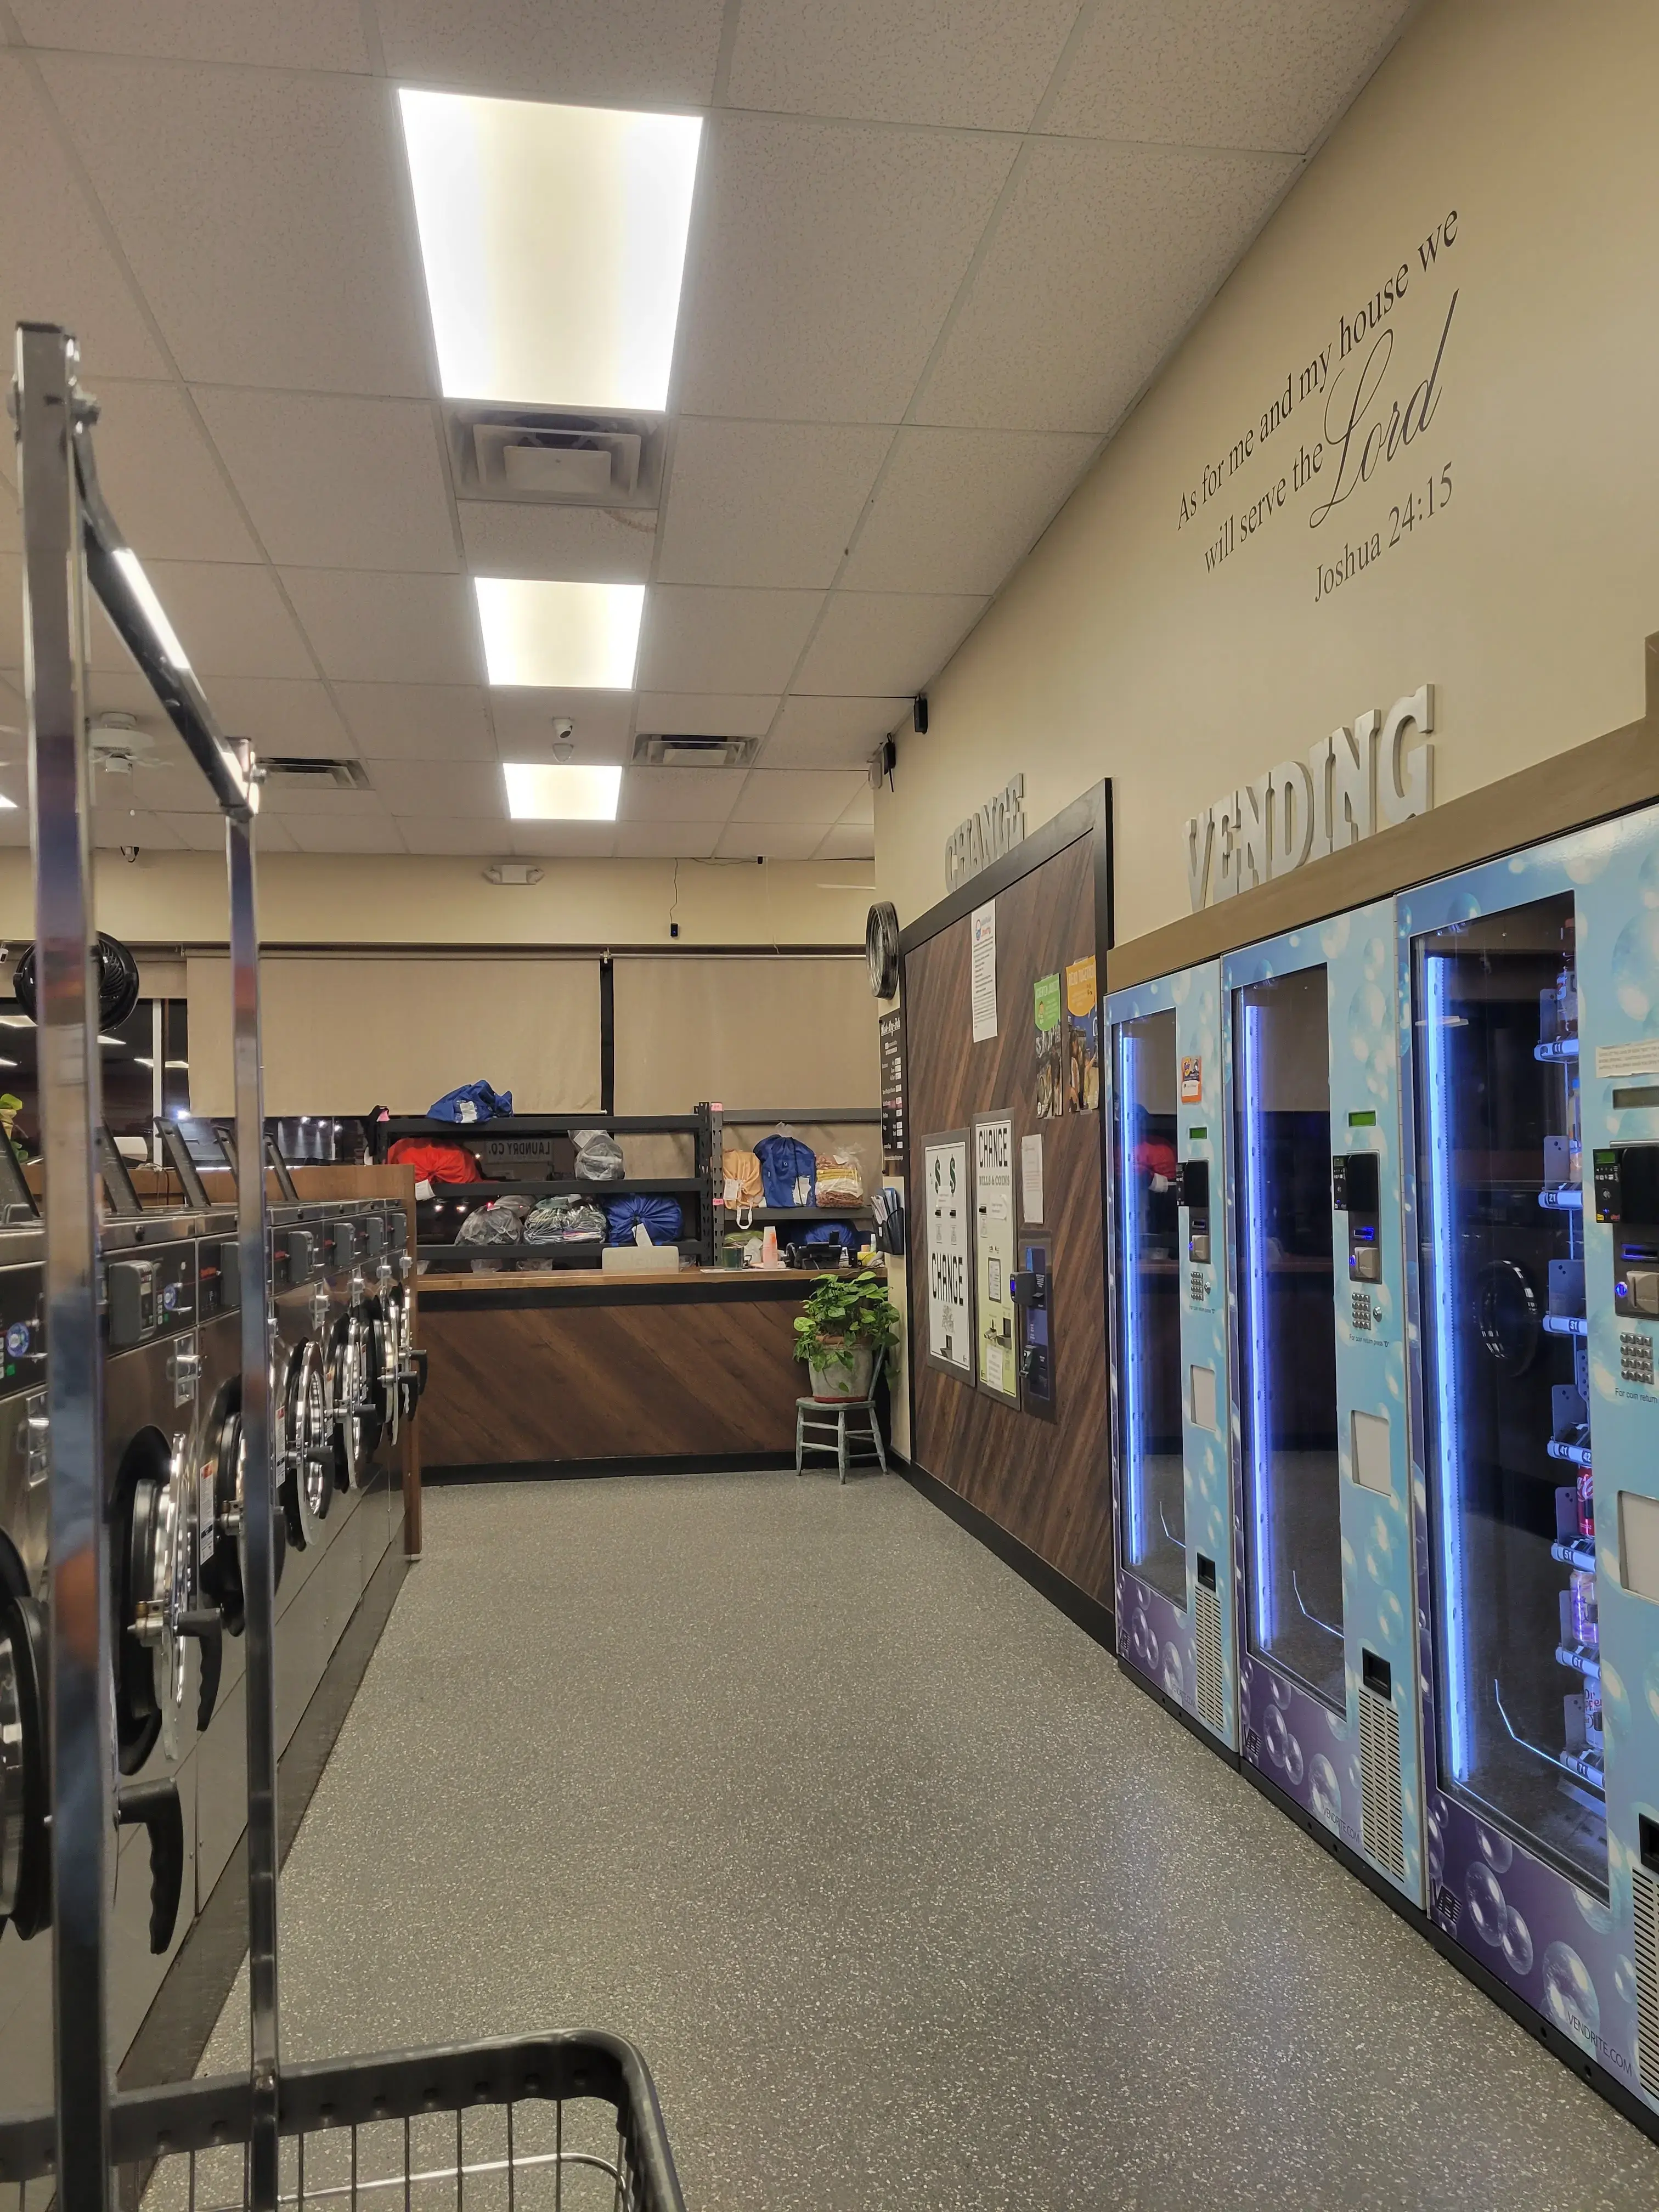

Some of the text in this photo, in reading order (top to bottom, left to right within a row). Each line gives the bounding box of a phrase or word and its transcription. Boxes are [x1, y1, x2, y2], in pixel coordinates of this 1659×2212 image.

[1178, 210, 1458, 531] As for me and my house we
[1204, 288, 1459, 574] will serve the Lord
[1315, 461, 1453, 602] Joshua 24:15
[1181, 684, 1435, 911] VENDING
[945, 772, 1024, 894] CHANGE
[1554, 1043, 1561, 1052] 11
[979, 1127, 1008, 1168] CHANGE
[1548, 1193, 1556, 1203] 21
[932, 1252, 964, 1307] CHANGE
[1570, 1321, 1578, 1330] 31
[1615, 1387, 1658, 1404] For coin return
[1560, 1446, 1592, 1463] 41 42
[1564, 1550, 1572, 1560] 51
[1573, 1657, 1581, 1668] 61
[1584, 1689, 1595, 1700] Dr
[1578, 1763, 1585, 1775] 71
[1567, 2010, 1633, 2078] VENDRITE.COM
